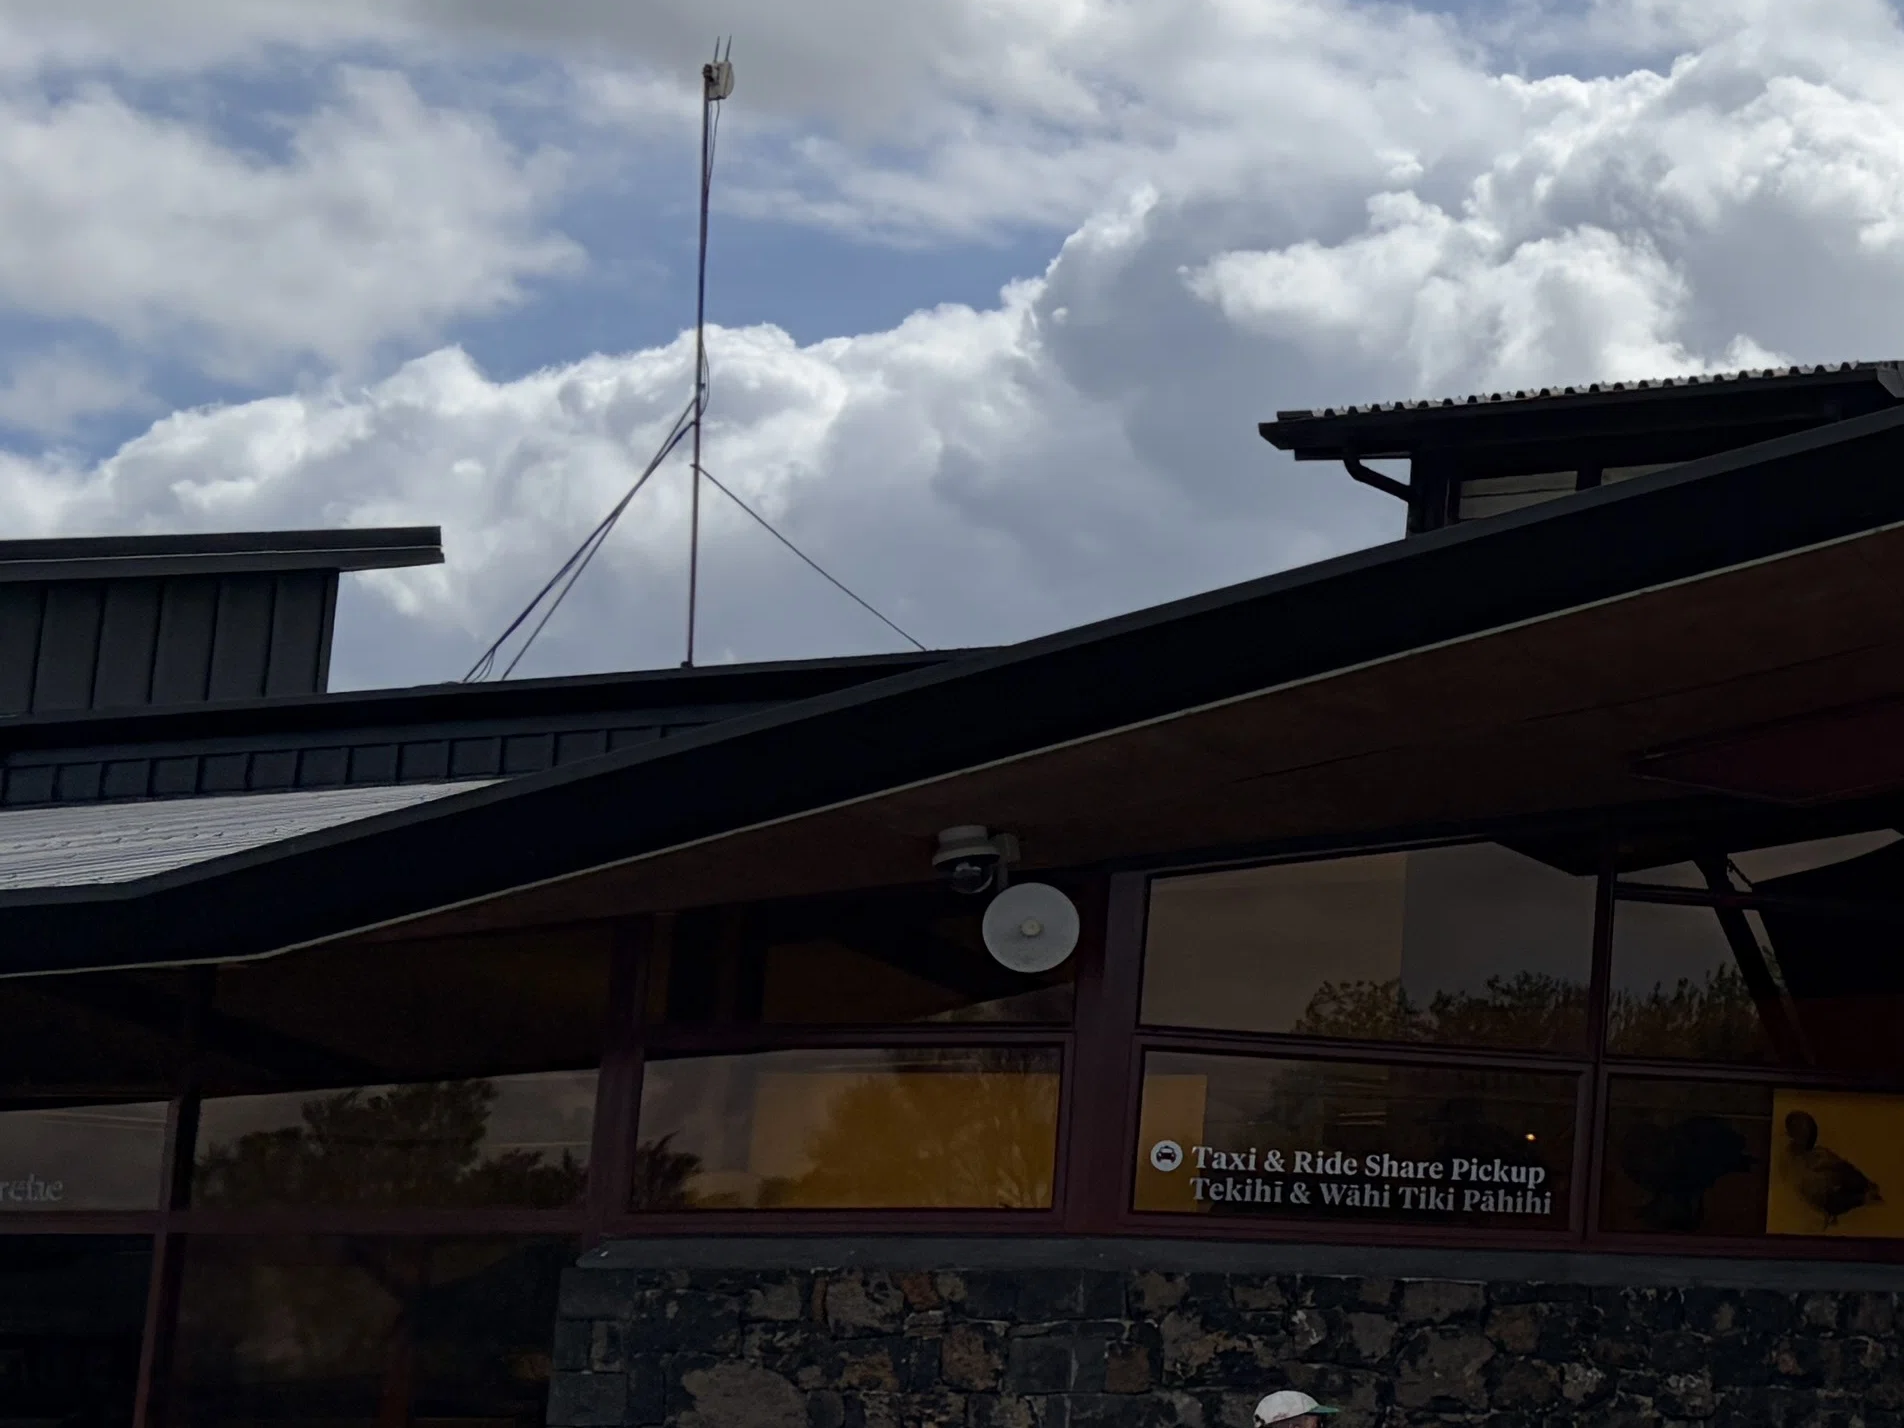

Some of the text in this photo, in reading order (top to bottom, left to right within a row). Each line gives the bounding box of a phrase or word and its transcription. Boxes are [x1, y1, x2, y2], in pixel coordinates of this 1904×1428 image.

[1192, 1145, 1546, 1188] Taxi & Ride Share Pickup
[1190, 1177, 1552, 1215] Tekihī & Wāhi Tiki Pāhihi
